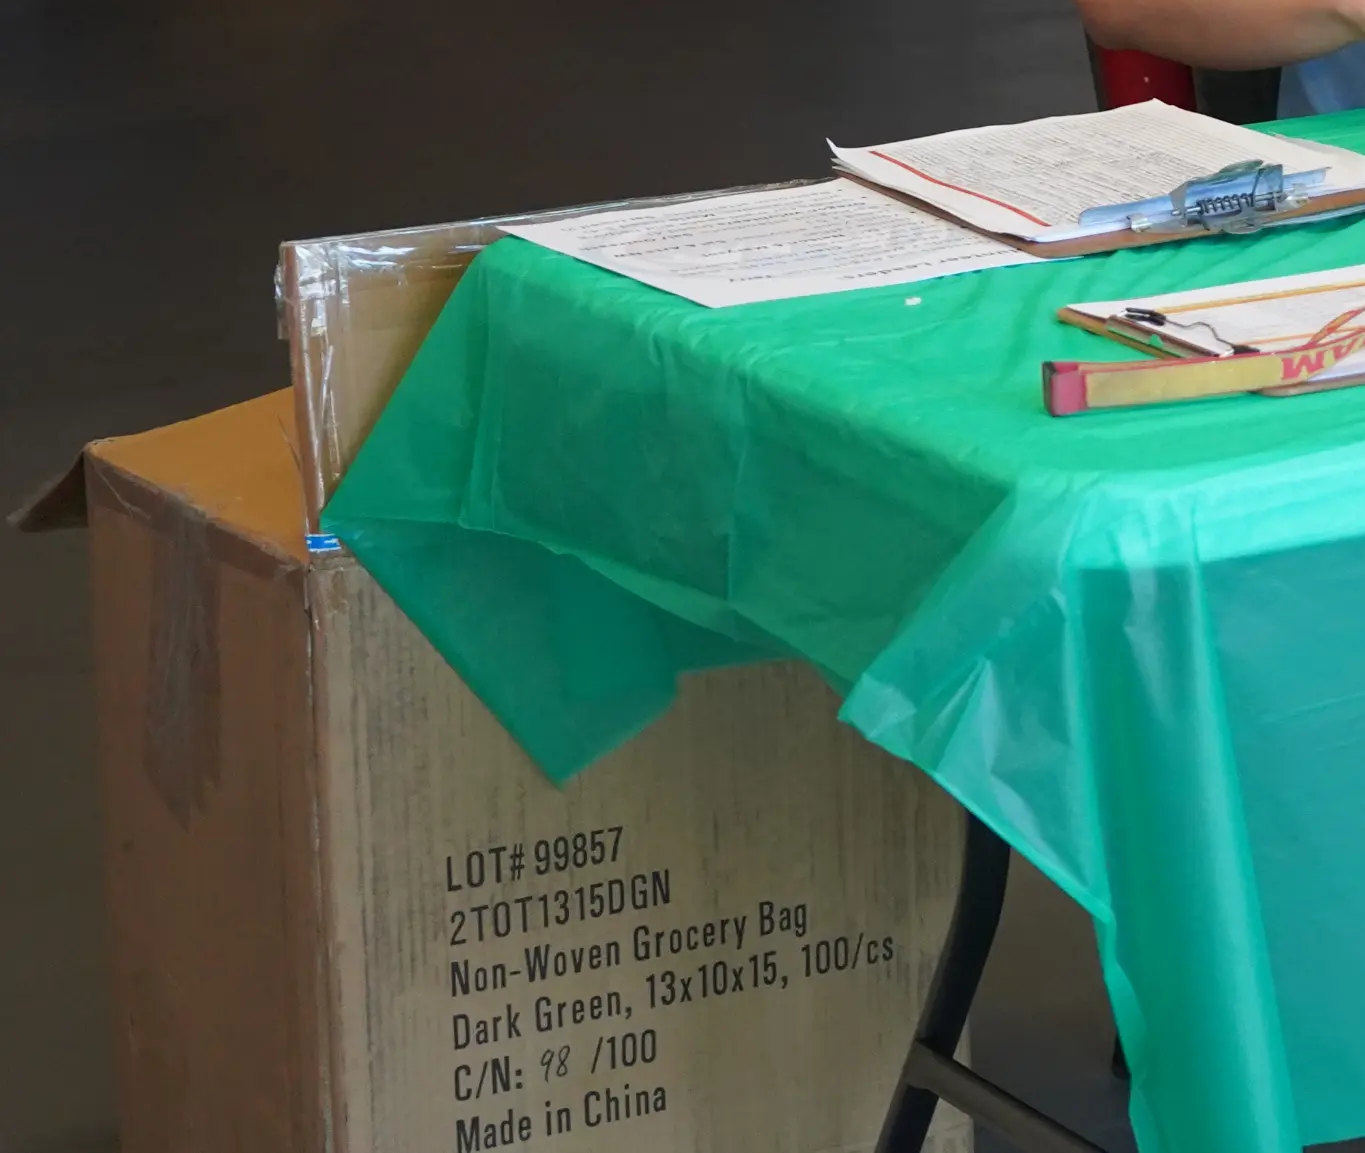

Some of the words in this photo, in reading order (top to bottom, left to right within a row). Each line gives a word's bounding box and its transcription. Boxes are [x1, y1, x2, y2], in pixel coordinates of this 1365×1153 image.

[446, 843, 525, 892] LOT#
[534, 826, 623, 876] 99857
[450, 939, 621, 997] Non-Woven
[633, 912, 747, 962] Grocery
[758, 901, 808, 938] Bag
[452, 1004, 522, 1050] Dark
[535, 990, 633, 1033] Green,
[646, 951, 789, 1010] 13x10x15,
[801, 933, 895, 977] 100/cs
[454, 1056, 524, 1102] C/N:
[590, 1029, 657, 1074] /100
[456, 1114, 532, 1153] Made
[545, 1101, 572, 1136] in
[584, 1083, 667, 1128] China
